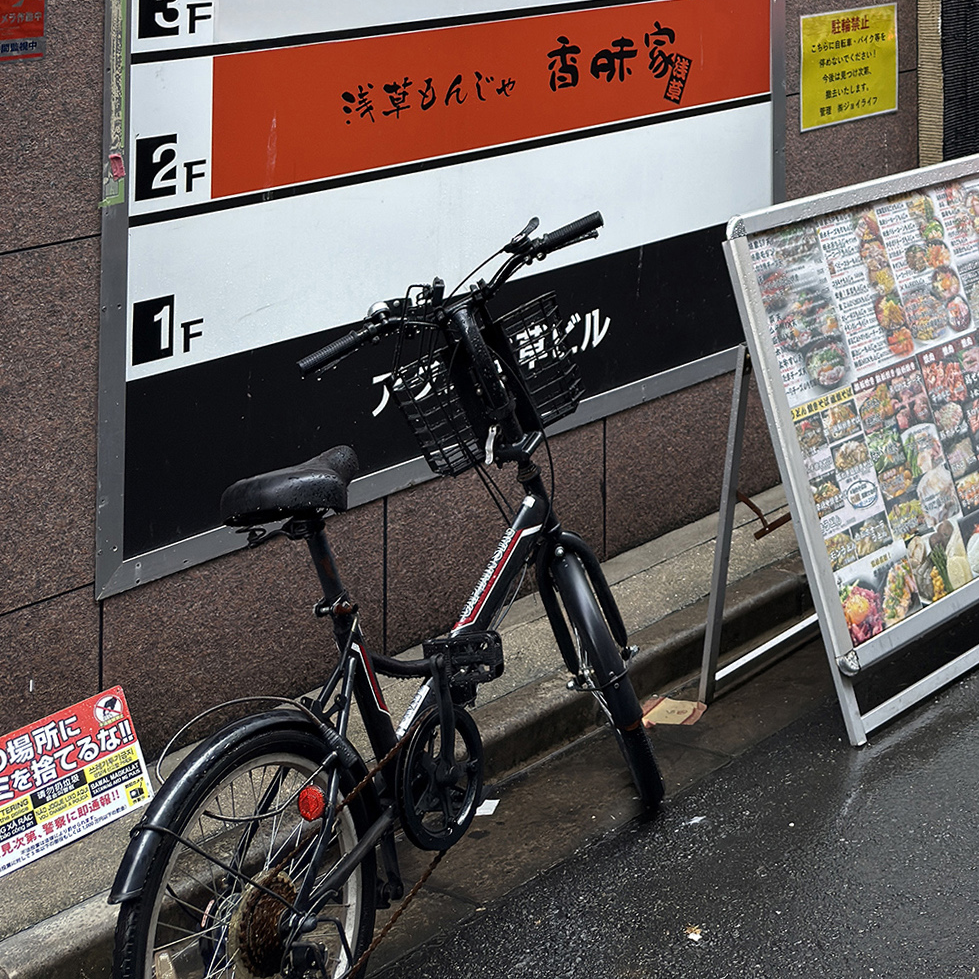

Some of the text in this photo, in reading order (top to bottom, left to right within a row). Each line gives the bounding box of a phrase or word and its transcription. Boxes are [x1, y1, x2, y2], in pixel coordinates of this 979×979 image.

[811, 32, 886, 53] こちらに自転車・バイク等を
[831, 15, 869, 35] 駐輪禁止
[341, 21, 676, 125] 浅草もんじゃ 香味家
[146, 140, 206, 196] 2F
[146, 302, 204, 354] 1F
